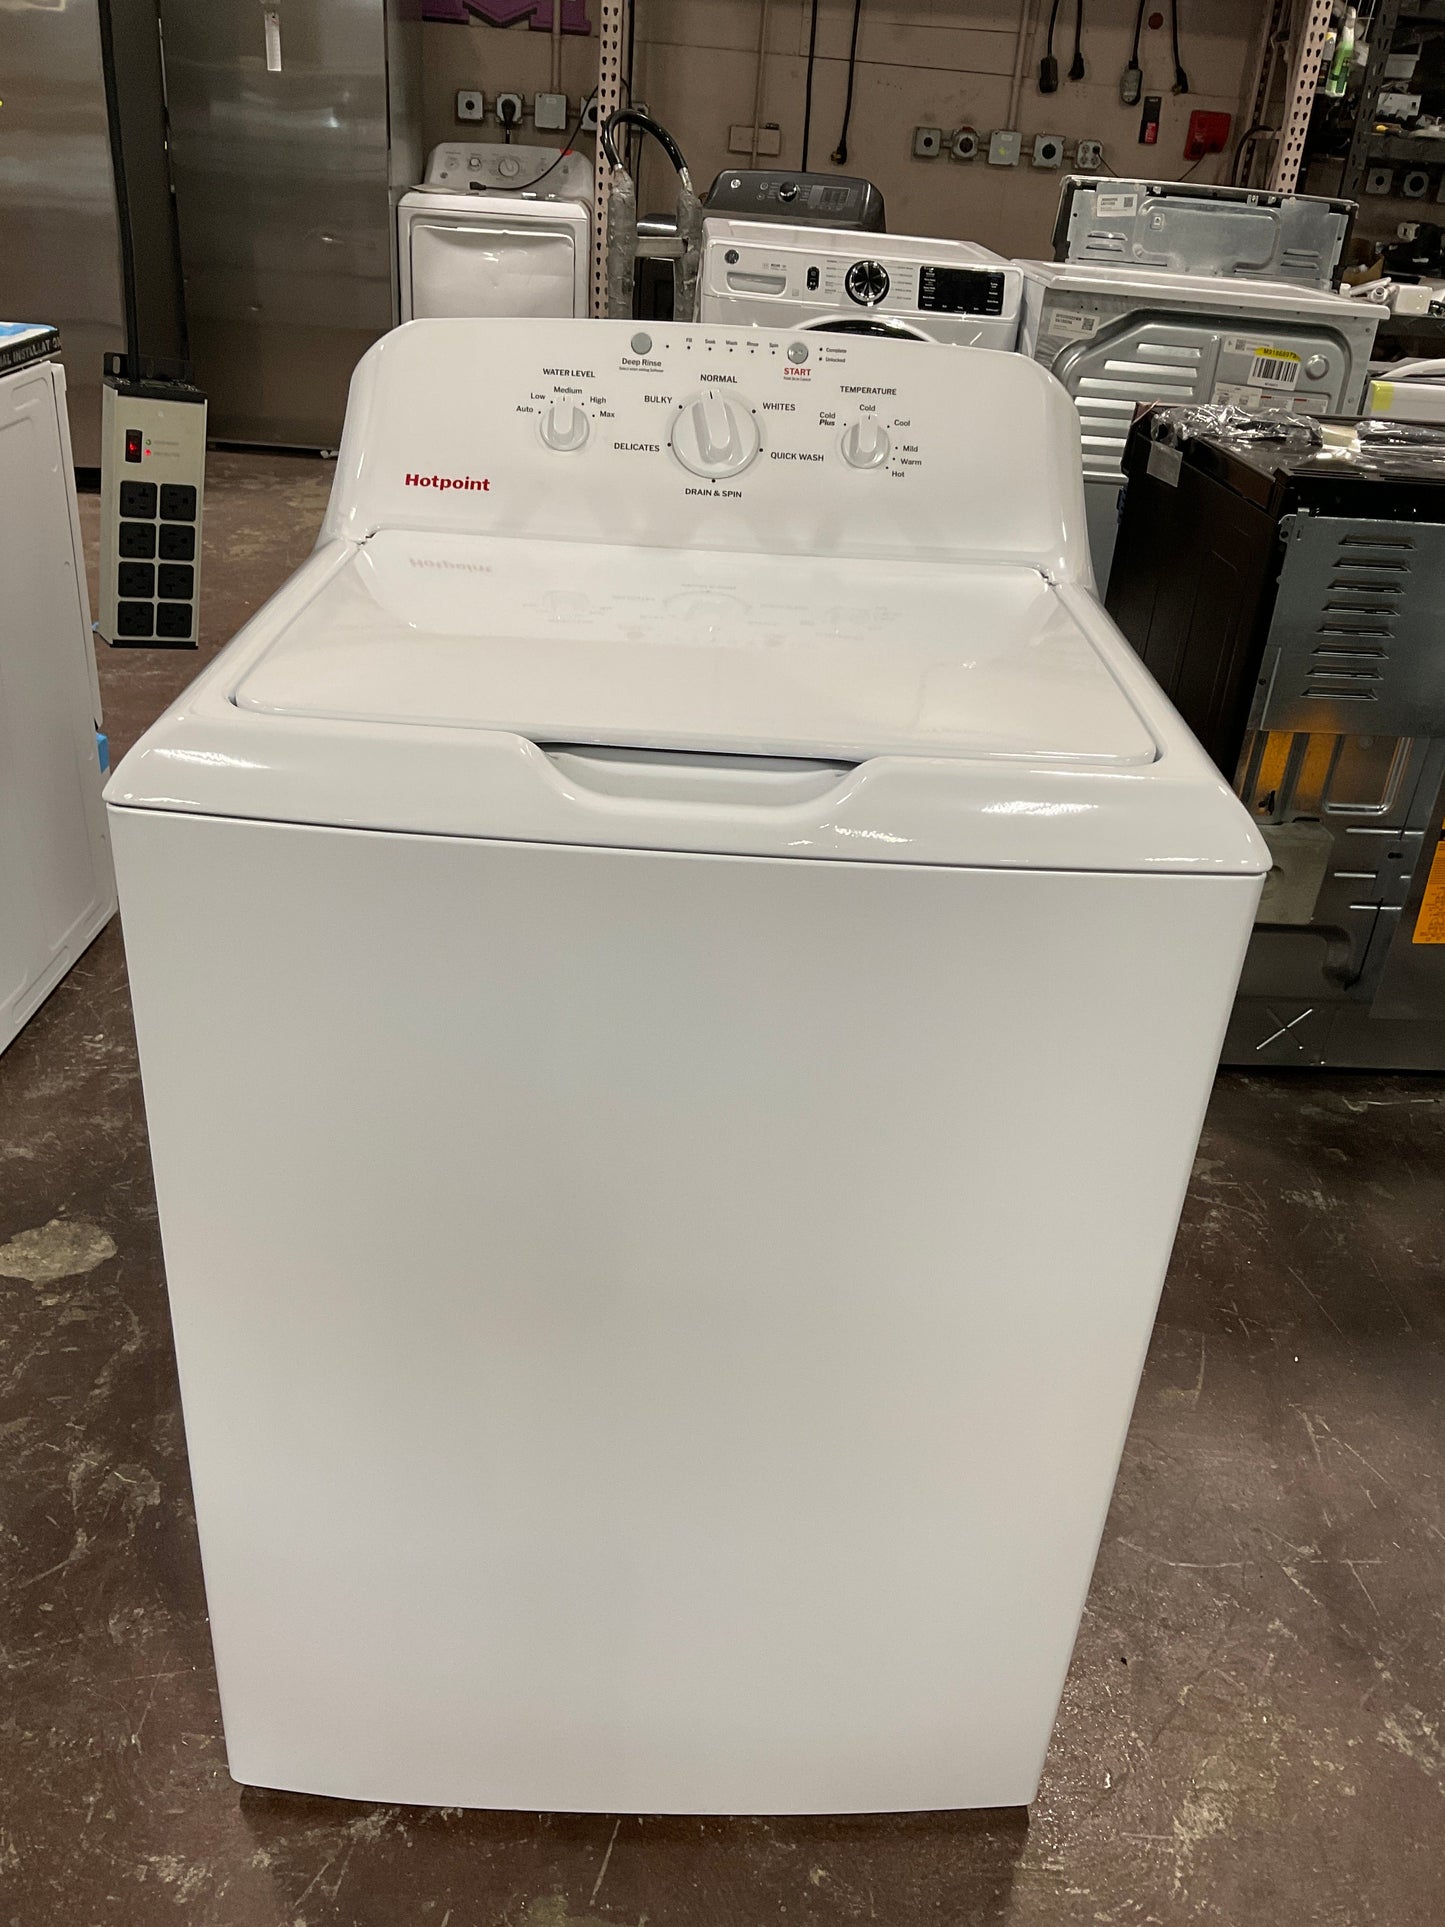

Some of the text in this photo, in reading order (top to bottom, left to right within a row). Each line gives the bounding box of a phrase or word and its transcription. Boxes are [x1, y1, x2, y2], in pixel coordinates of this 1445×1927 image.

[621, 357, 662, 367] Deep Rinse
[542, 367, 596, 378] WATER LEVEL
[783, 367, 812, 377] START
[700, 373, 738, 384] NORMAL
[553, 385, 583, 395] Medium
[839, 385, 897, 396] TEMPERATURE
[530, 392, 546, 400] Low
[589, 395, 607, 405] High
[644, 394, 673, 404] BULKY
[515, 405, 534, 413] Auto
[762, 401, 796, 412] WHITES
[859, 403, 876, 412] Cold
[599, 410, 615, 418] Max
[819, 411, 836, 419] Cold
[818, 419, 836, 427] Plus
[893, 418, 911, 427] Cool
[613, 442, 660, 453] DELICATES
[902, 444, 919, 453] Mild
[770, 451, 825, 462] QUICK WASH
[900, 457, 922, 466] Warm
[891, 470, 905, 478] Hot
[404, 473, 491, 492] Hotpoint
[684, 487, 742, 499] DRAIN & SPIN
